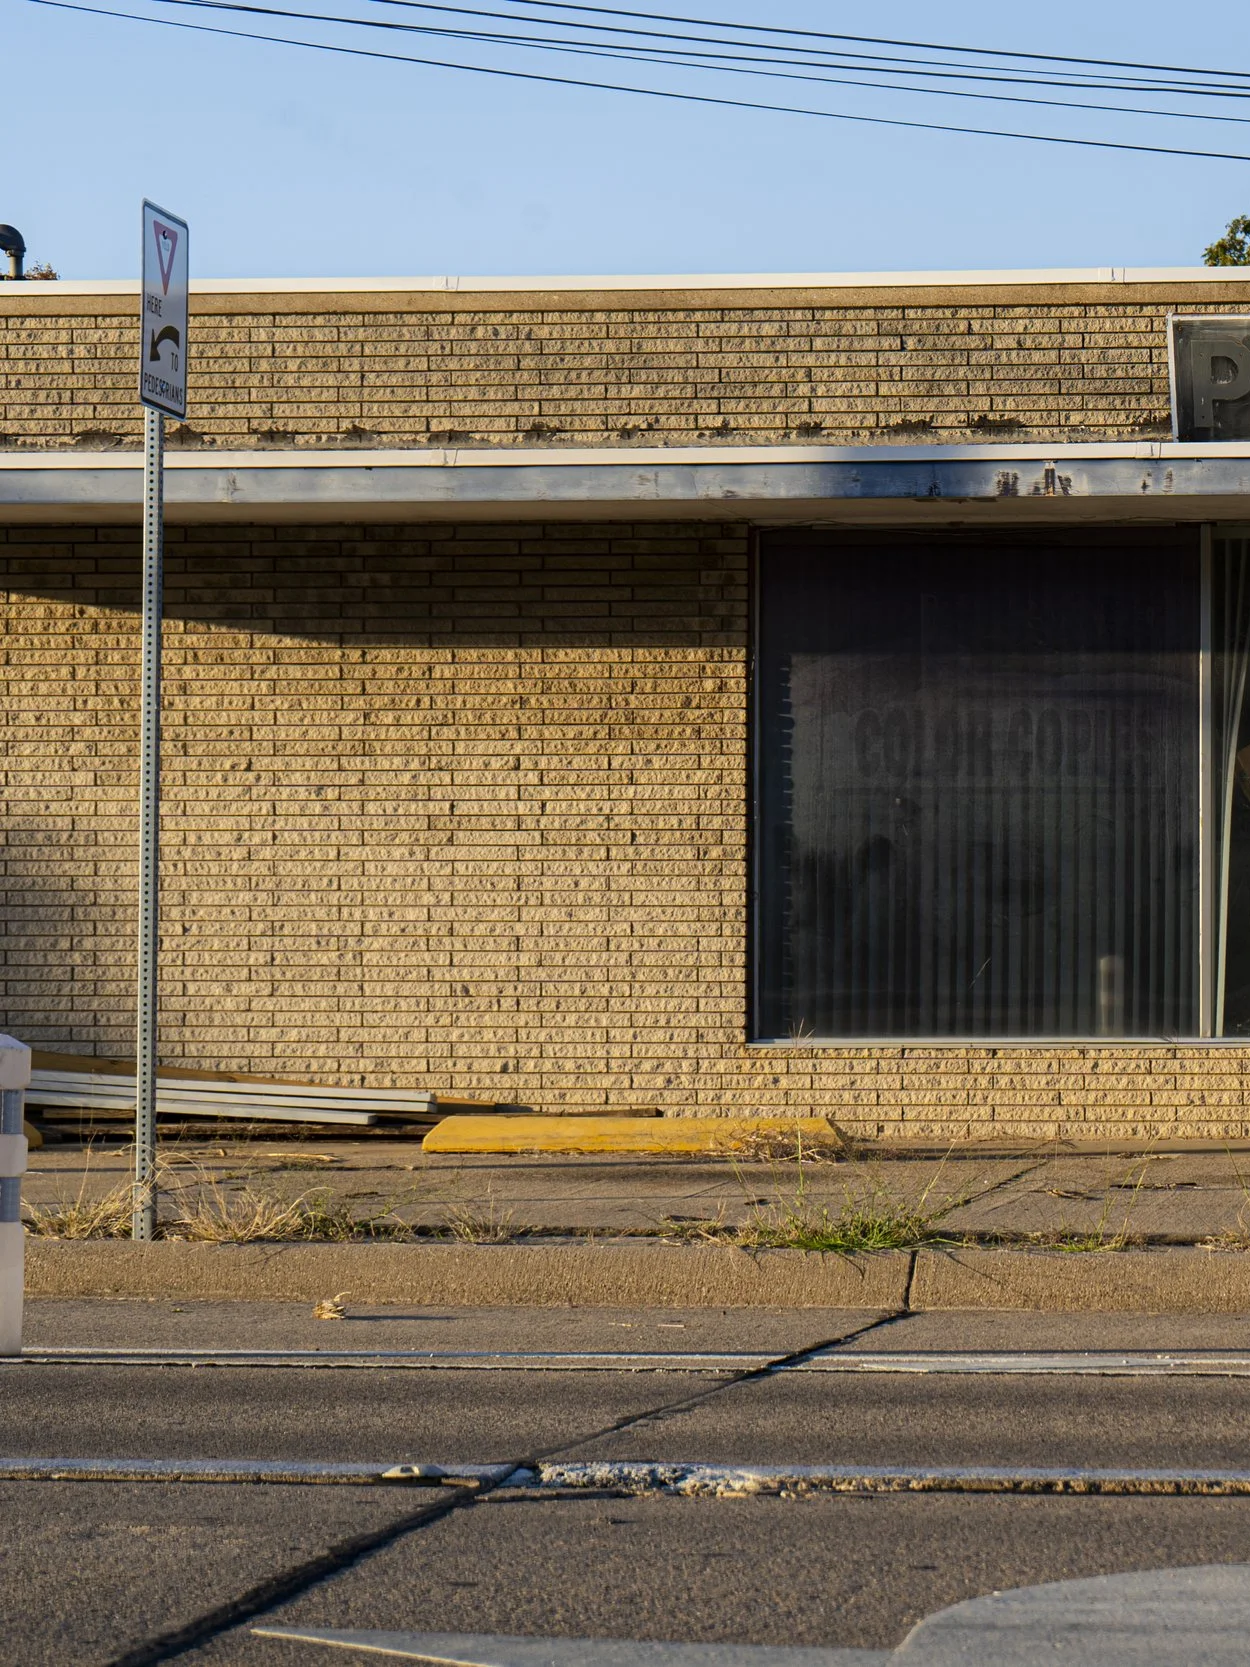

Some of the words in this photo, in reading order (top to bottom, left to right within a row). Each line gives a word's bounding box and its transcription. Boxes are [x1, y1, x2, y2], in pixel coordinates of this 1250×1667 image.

[147, 293, 162, 318] HERE
[171, 352, 179, 372] TO
[144, 372, 183, 406] PEDESTRIANS
